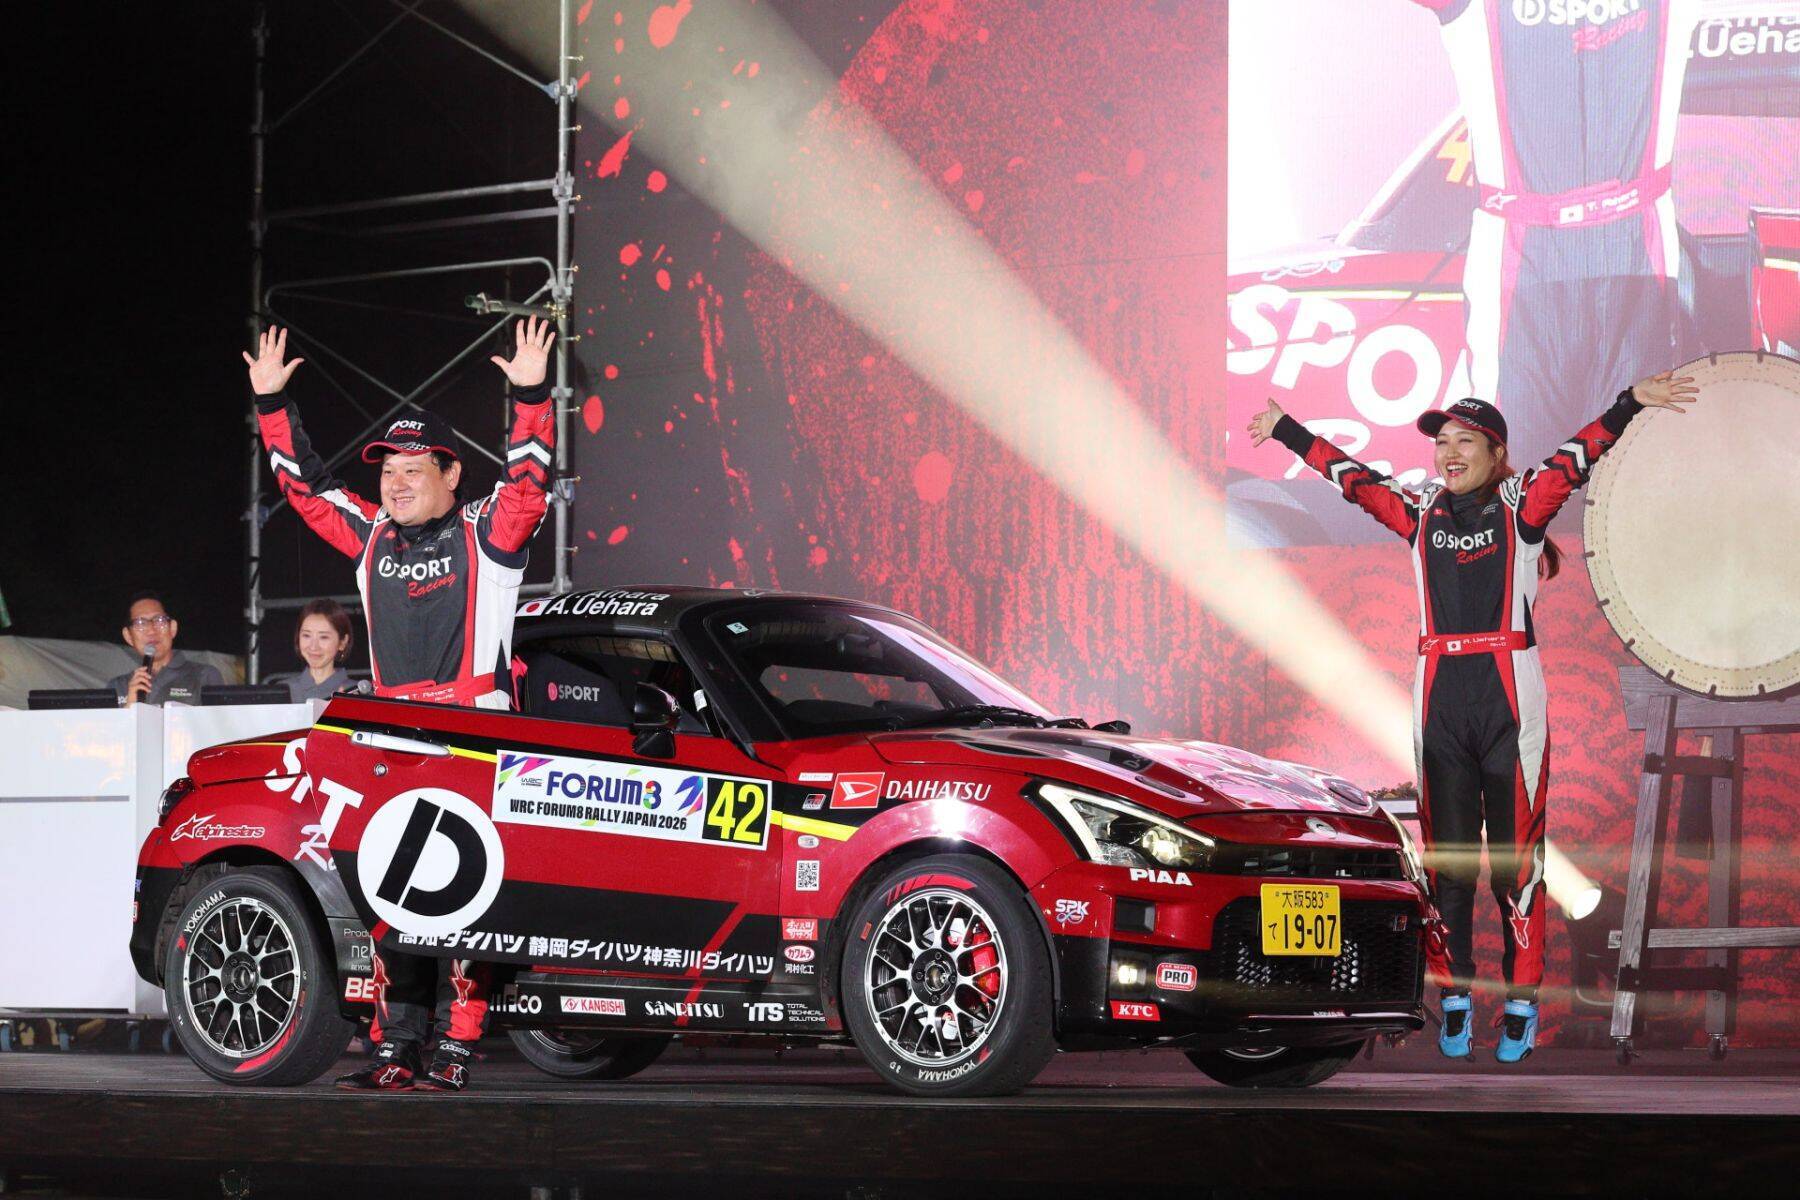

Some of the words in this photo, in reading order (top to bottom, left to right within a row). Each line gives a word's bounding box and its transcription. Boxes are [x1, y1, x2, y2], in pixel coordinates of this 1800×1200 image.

[1437, 122, 1475, 186] 4
[1458, 400, 1483, 410] ORT
[1446, 529, 1495, 551] SPORT
[1456, 544, 1499, 564] Racing
[408, 573, 457, 597] Racing
[558, 684, 600, 702] SPORT
[546, 771, 662, 810] FORUM8
[885, 780, 991, 801] DAIHATSU
[510, 799, 535, 815] WRC
[536, 801, 584, 820] FORUM8
[584, 807, 621, 824] RALLY
[621, 811, 657, 828] JAPAN
[657, 816, 687, 831] 2026
[707, 781, 765, 844] 42
[195, 824, 266, 841] alpinestars
[1129, 868, 1194, 886] PIAA
[184, 890, 227, 934] YOKOHAMA
[1055, 899, 1090, 915] SPK
[1268, 922, 1278, 941] て
[1284, 914, 1337, 950] 19-07
[528, 936, 642, 962] 静岡ダイハツ
[642, 946, 774, 975] 神奈川ダイハツ
[787, 948, 812, 959] カワムラ
[1164, 970, 1189, 984] PRO
[580, 998, 625, 1014] KANBISHI
[1119, 1004, 1153, 1017] KTC
[918, 1059, 977, 1081] YOKOHAMA
